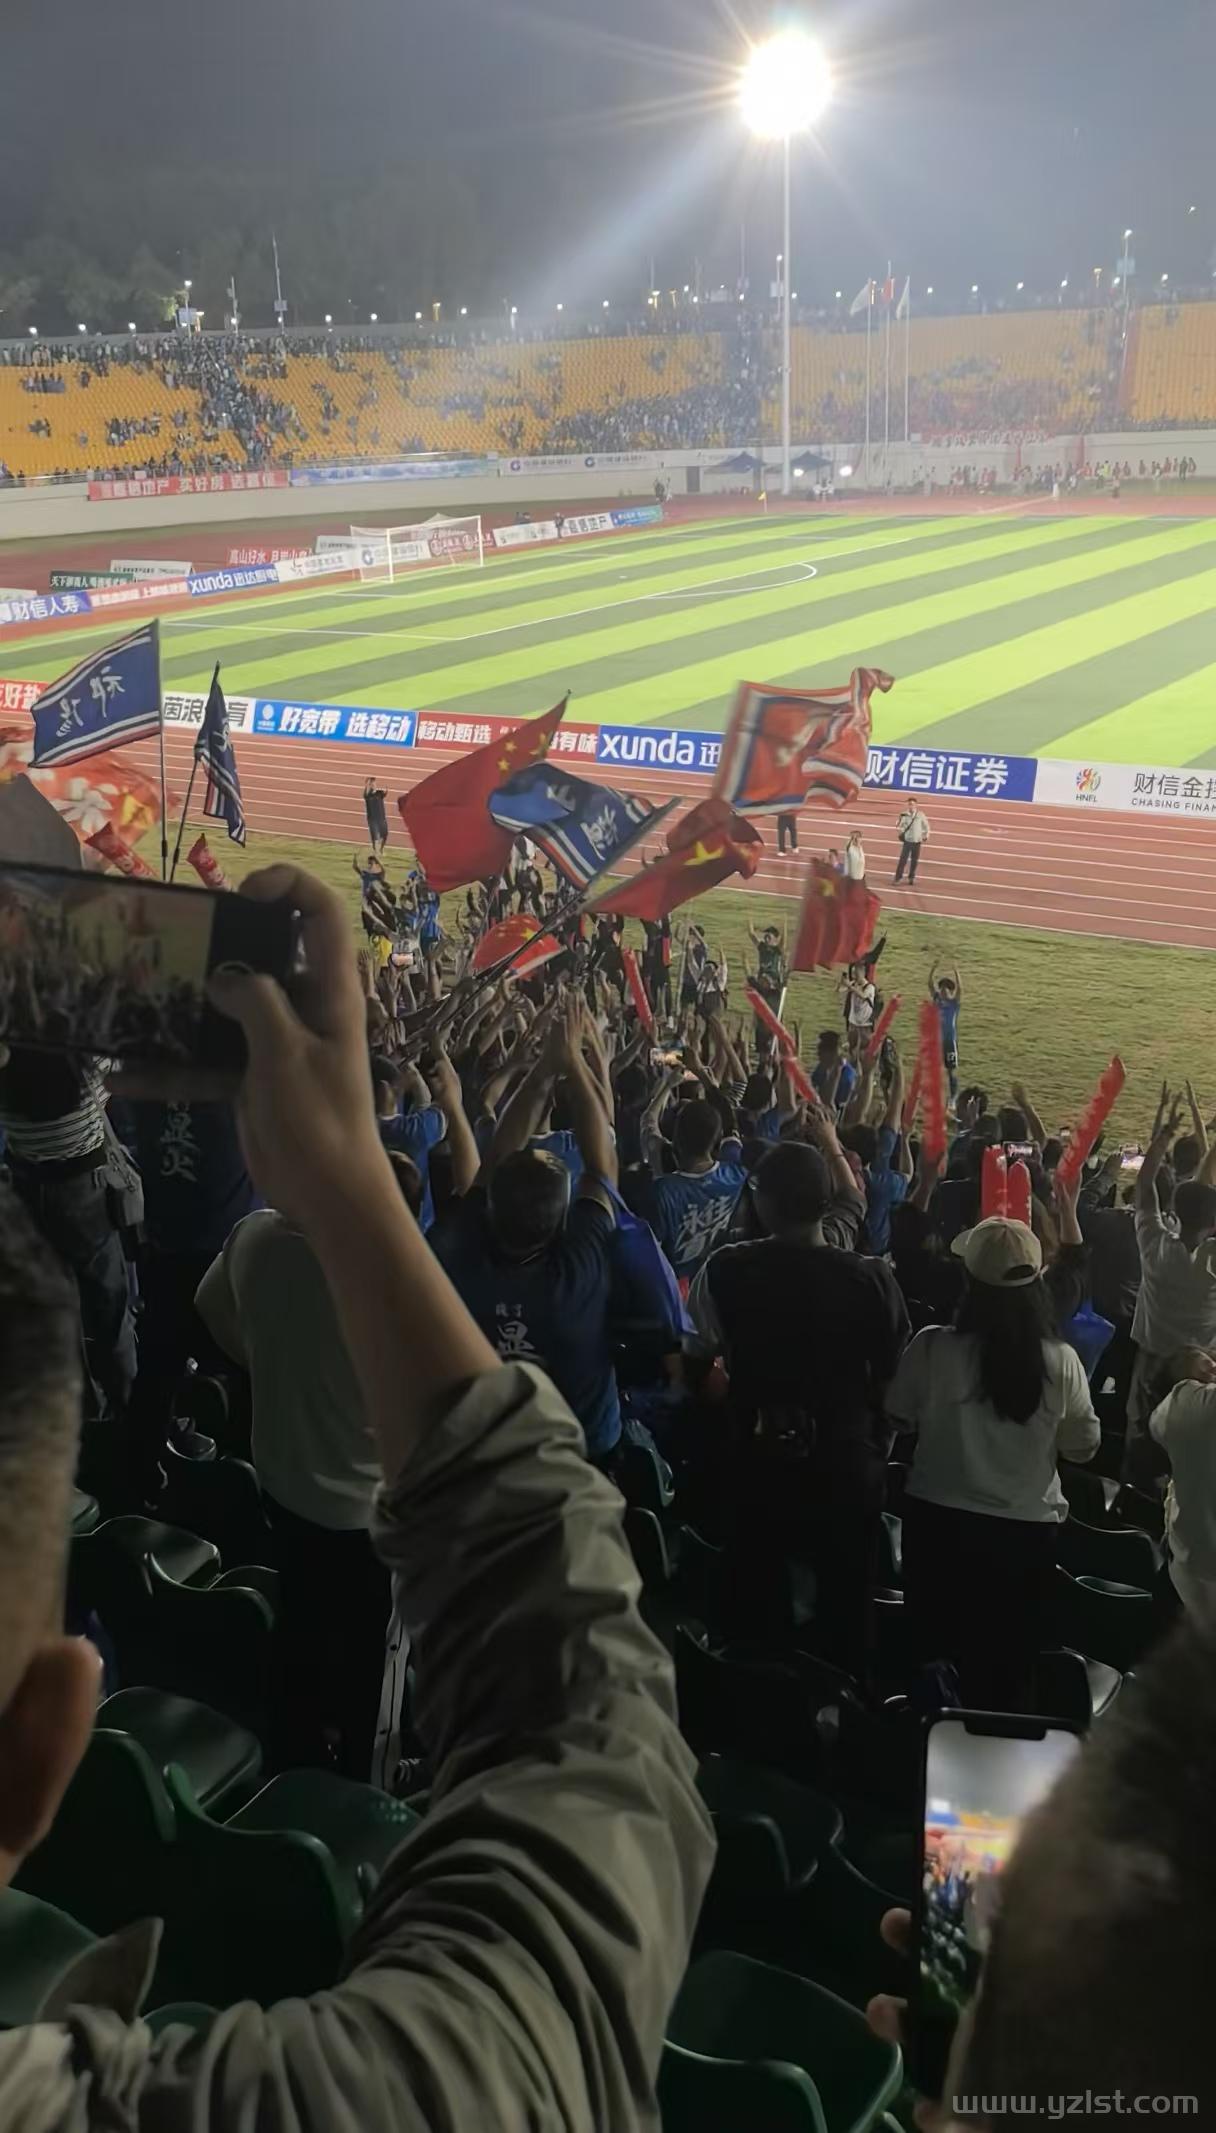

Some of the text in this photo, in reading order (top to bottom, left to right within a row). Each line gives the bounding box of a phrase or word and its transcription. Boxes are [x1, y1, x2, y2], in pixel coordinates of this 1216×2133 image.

[190, 572, 233, 593] xunda
[162, 696, 248, 727] 茵浪育
[278, 706, 411, 742] 好宽带 选移动
[418, 720, 491, 744] 移动甄选
[600, 732, 695, 765] xunda
[864, 750, 1009, 795] 财信证券
[1131, 798, 1180, 809] CHASING
